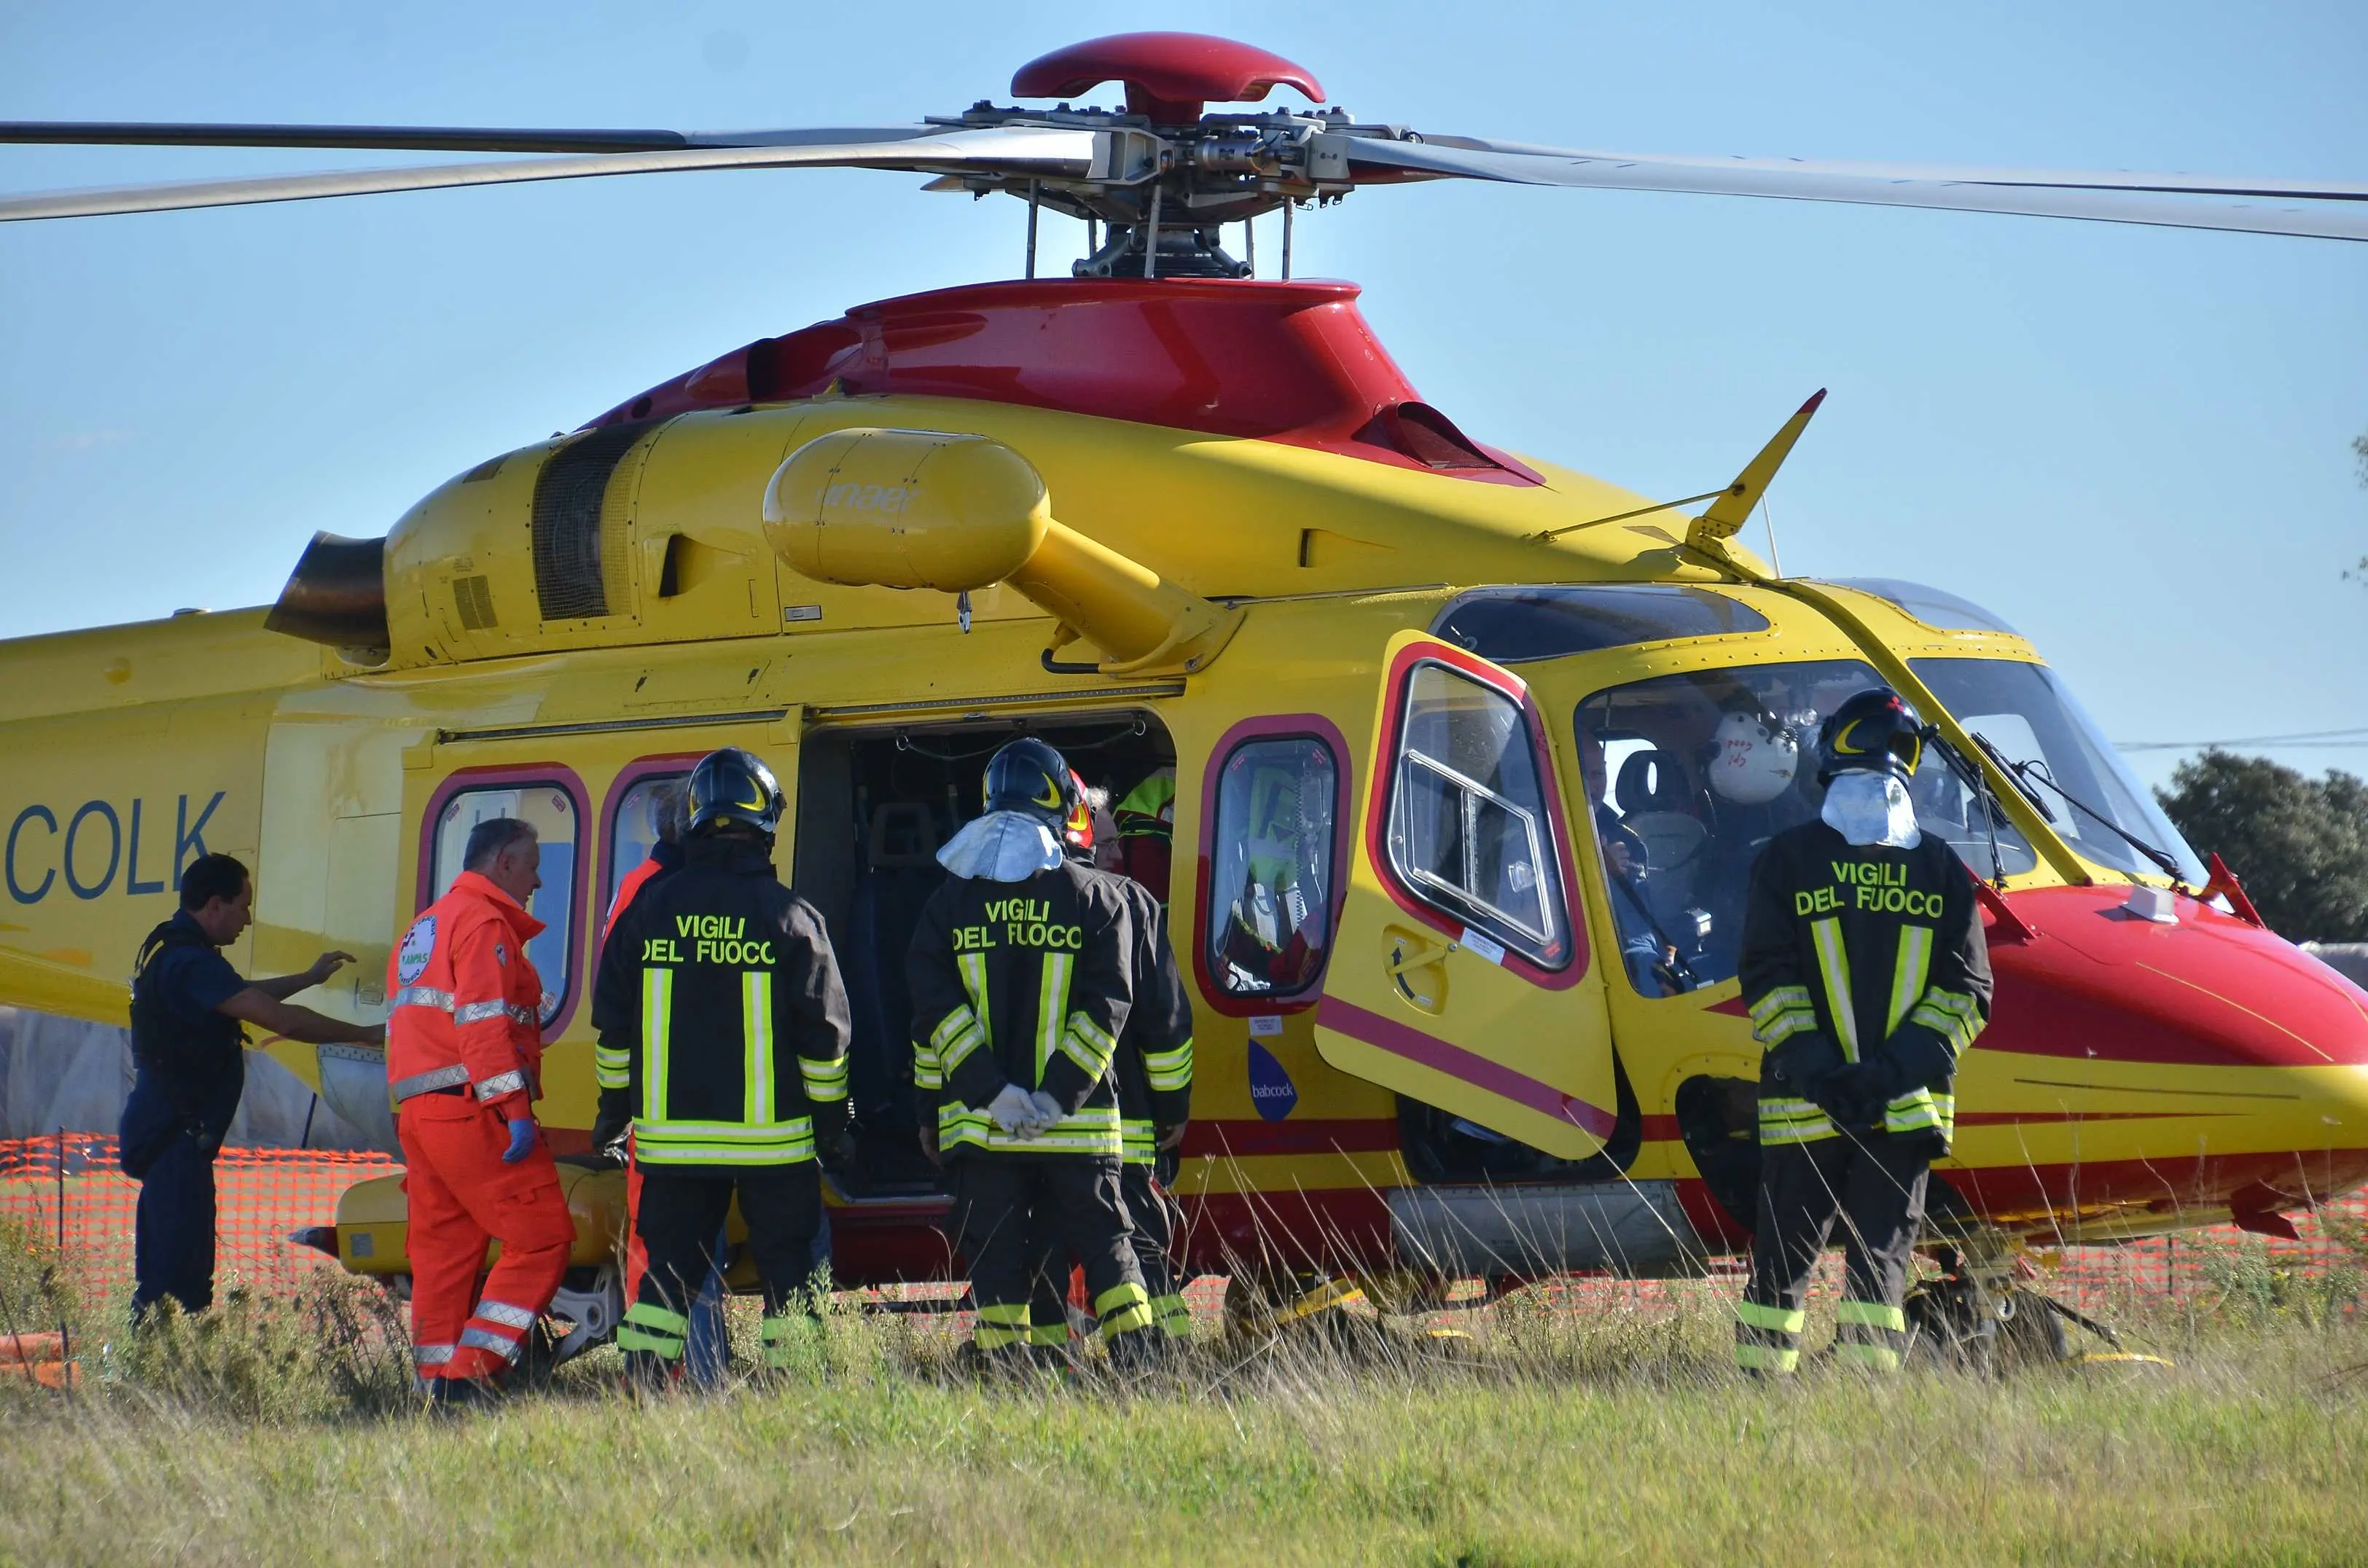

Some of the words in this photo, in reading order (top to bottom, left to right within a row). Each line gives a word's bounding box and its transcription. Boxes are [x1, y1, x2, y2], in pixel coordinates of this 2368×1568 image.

[4, 791, 227, 905] COLK
[1831, 860, 1907, 887] VIGILI
[985, 898, 1050, 922] VIGILI
[1795, 885, 1845, 916] DEL
[1856, 885, 1943, 919] FUOCO
[676, 915, 746, 939] VIGILI
[1008, 922, 1082, 950] FUOCO
[697, 940, 775, 964] FUOCO
[1252, 1083, 1294, 1097] babcock
